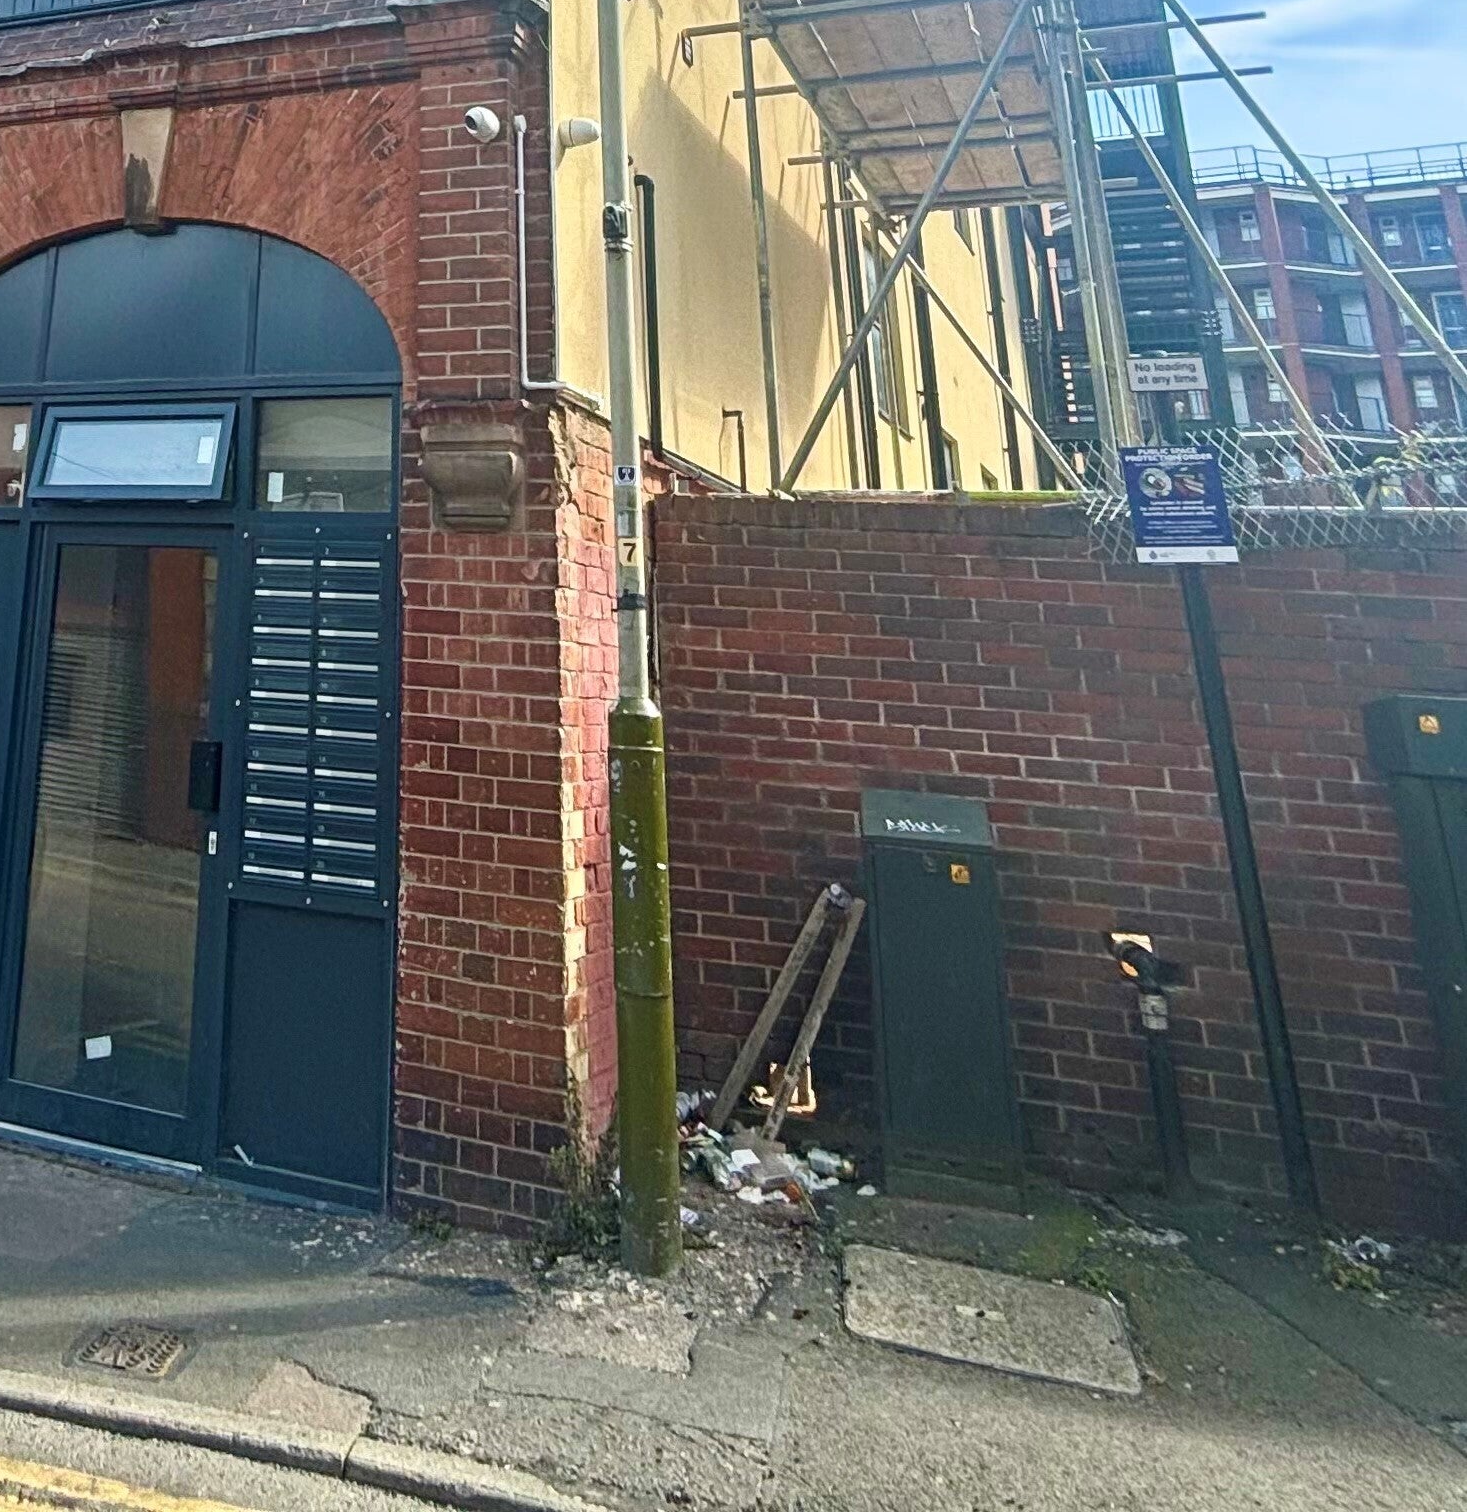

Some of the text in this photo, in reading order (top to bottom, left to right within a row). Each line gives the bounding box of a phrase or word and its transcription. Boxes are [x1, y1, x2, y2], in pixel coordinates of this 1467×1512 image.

[1134, 362, 1197, 373] No loading
[1137, 374, 1198, 386] at any time
[1124, 453, 1213, 462] PROTECTION ORDER
[623, 542, 636, 561] 7
